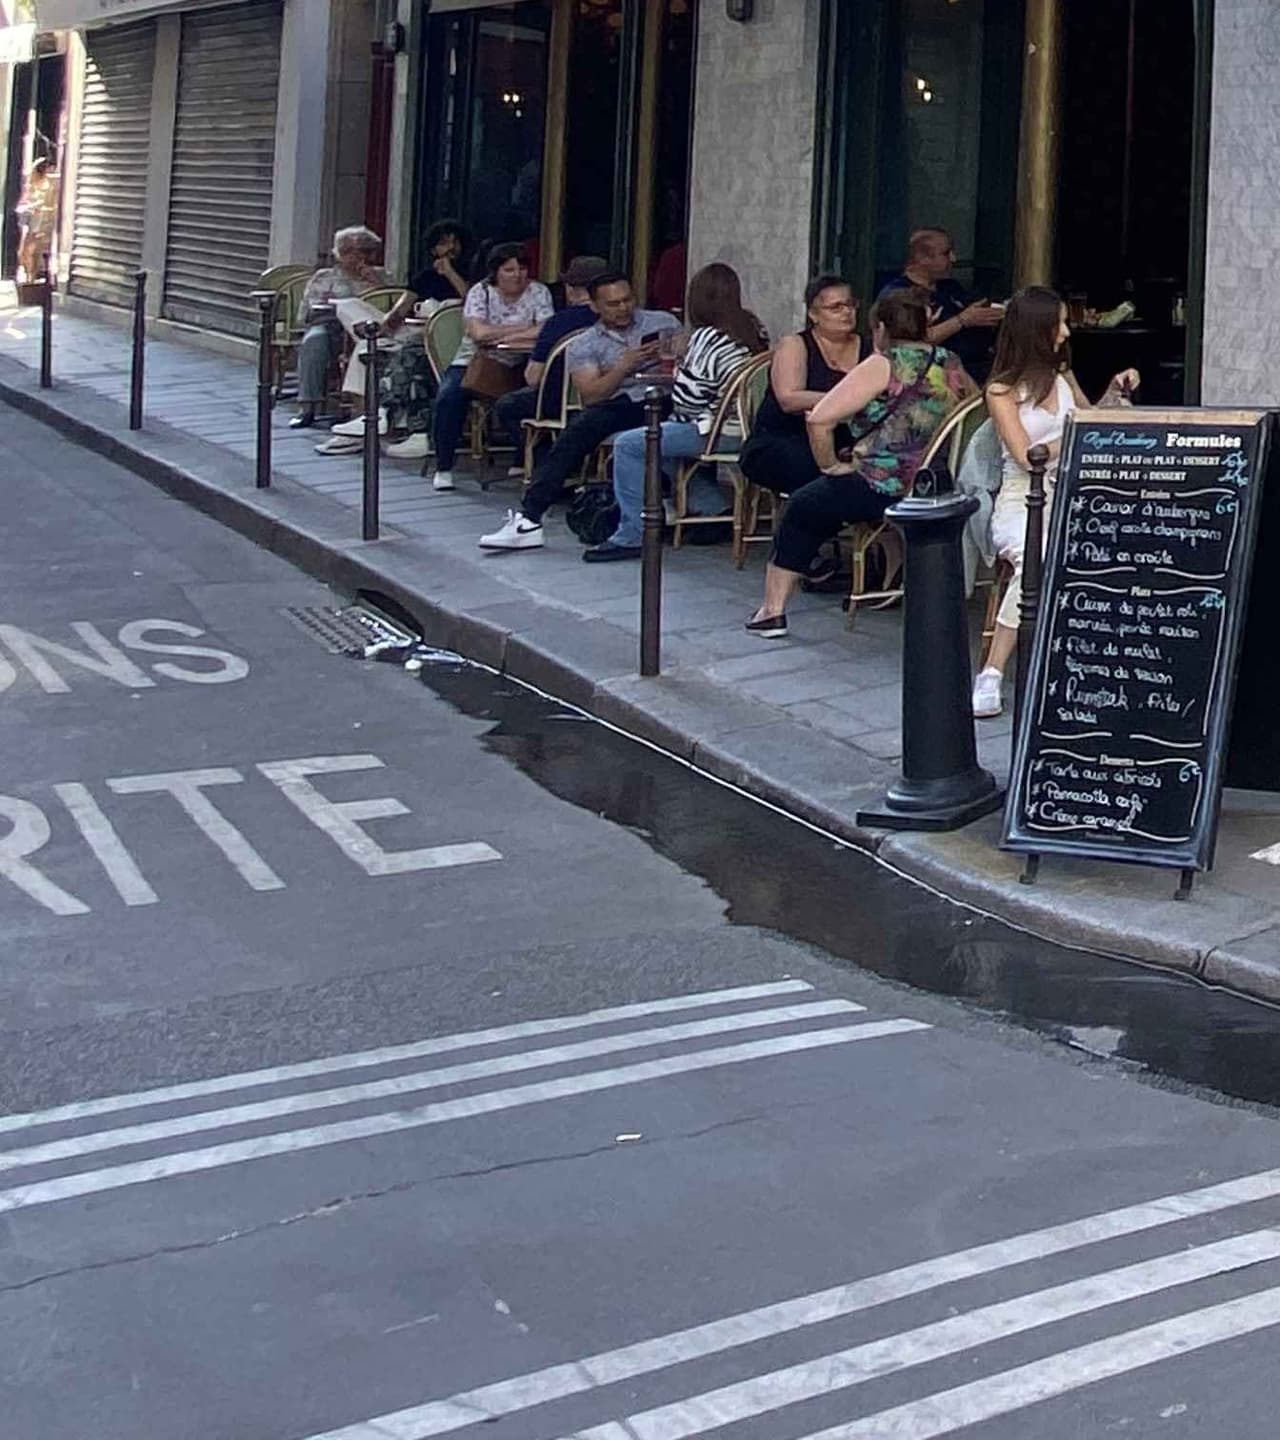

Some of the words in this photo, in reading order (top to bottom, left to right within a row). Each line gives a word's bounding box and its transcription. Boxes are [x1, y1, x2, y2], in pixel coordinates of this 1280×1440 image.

[1166, 433, 1242, 449] Formules
[1081, 454, 1113, 464] ENTRÉE
[1121, 454, 1142, 465] PLAT
[1154, 455, 1176, 465] PLAT
[1183, 456, 1221, 466] DESSERT
[1079, 469, 1112, 480] ENTRÉE
[1119, 471, 1140, 480] PLAT
[1149, 471, 1187, 482] DESSERT
